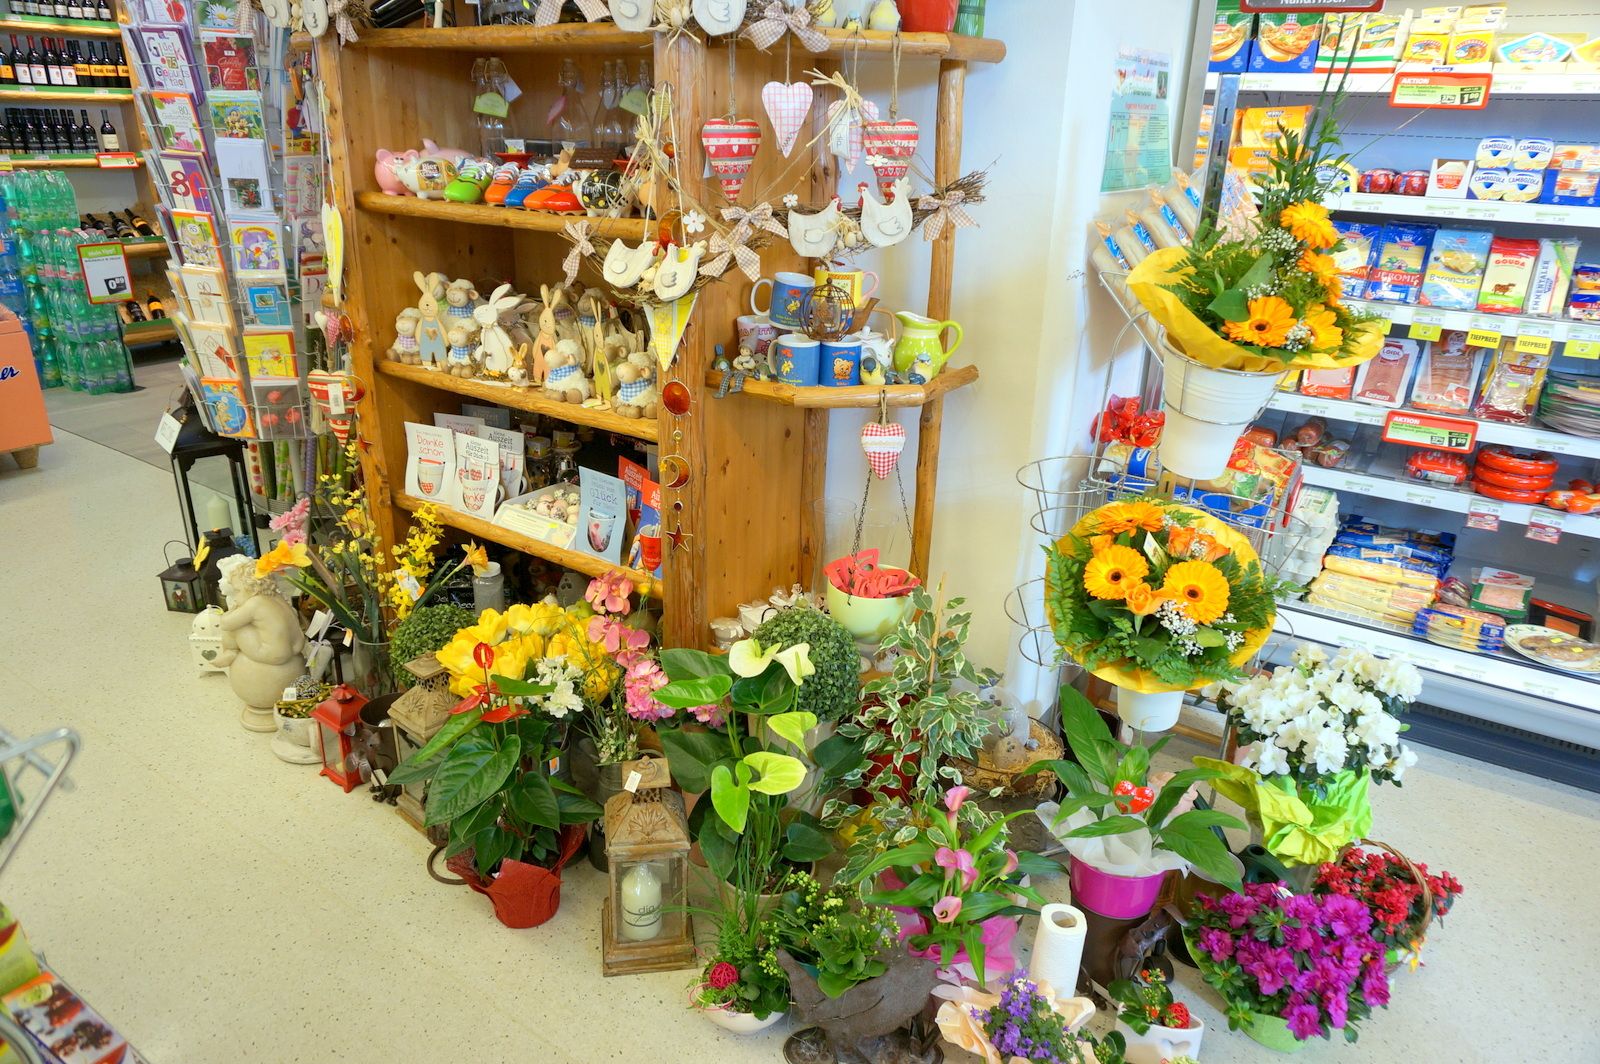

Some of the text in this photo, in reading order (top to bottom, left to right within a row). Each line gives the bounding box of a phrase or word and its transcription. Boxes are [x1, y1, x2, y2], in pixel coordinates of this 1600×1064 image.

[1400, 77, 1430, 85] AKTION
[1481, 143, 1513, 151] CAMBOZOLA
[1519, 144, 1552, 154] CAMBOZOLA
[1474, 175, 1506, 183] CAMBOZOLA
[1508, 176, 1540, 185] CAMBOZOLA
[171, 170, 207, 199] 80
[1494, 259, 1526, 268] GOUDA
[1375, 271, 1420, 283] JEROME
[1531, 260, 1550, 311] EMMENTALER
[1470, 334, 1498, 343] TIEFPREIS
[1519, 340, 1547, 349] TIEFPREIS
[1393, 416, 1421, 425] AKTION
[417, 434, 444, 448] Danke
[465, 442, 489, 455] Auszeit
